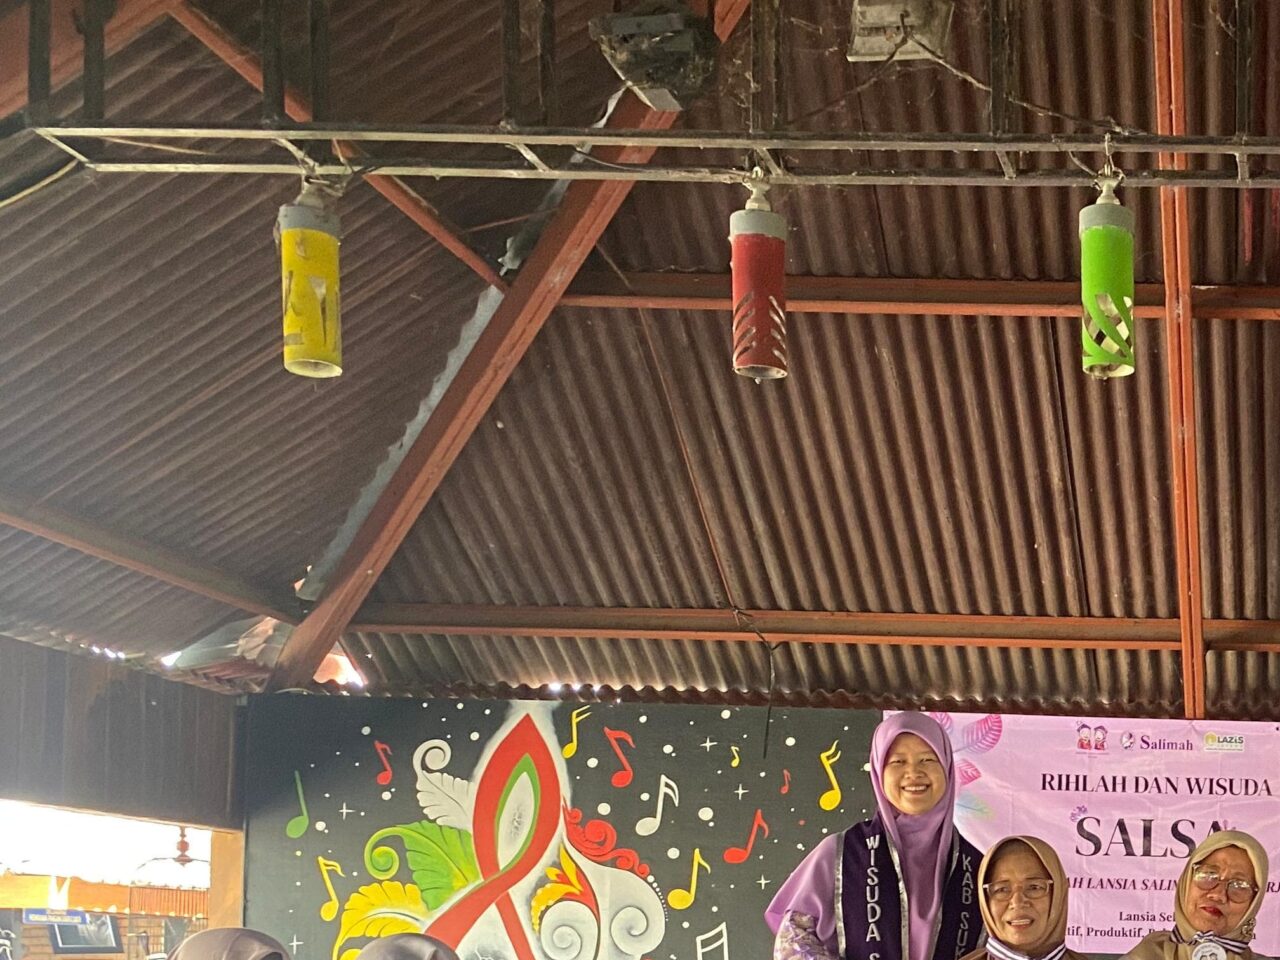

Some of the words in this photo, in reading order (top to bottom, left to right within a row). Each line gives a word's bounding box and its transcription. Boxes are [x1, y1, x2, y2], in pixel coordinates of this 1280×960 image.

[1140, 734, 1193, 751] Salimah
[1041, 773, 1127, 793] RIHLAH
[1134, 775, 1180, 795] DAN
[1186, 777, 1273, 797] WISUDA
[962, 854, 974, 904] KAB
[1087, 878, 1136, 890] LANSIA
[866, 834, 881, 942] WISUDA
[1119, 911, 1156, 922] Lansia
[1086, 927, 1145, 938] Produktif,
